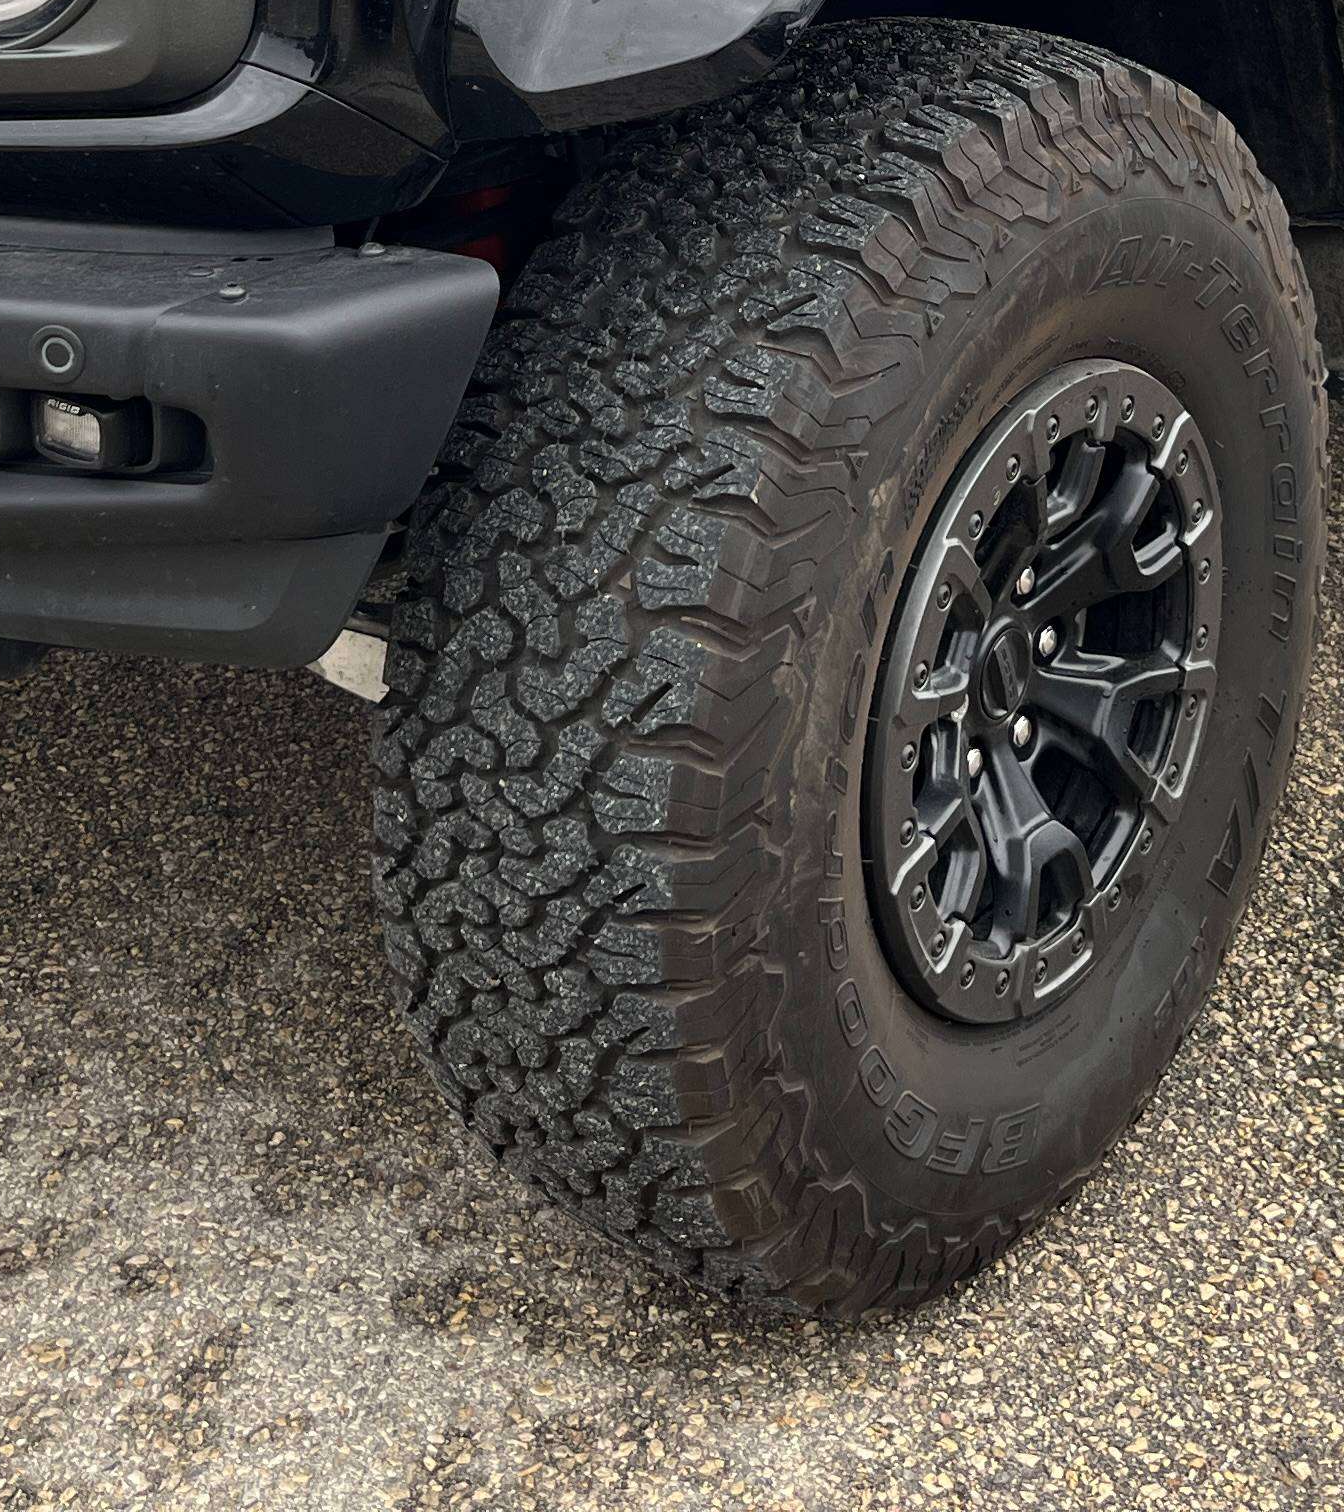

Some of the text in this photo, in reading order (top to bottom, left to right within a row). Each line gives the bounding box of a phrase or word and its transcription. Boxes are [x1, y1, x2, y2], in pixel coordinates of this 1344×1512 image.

[47, 398, 81, 414] RIGID
[1087, 234, 1304, 897] All-Terrain T/A
[819, 550, 1040, 1177] BFGoodrich
